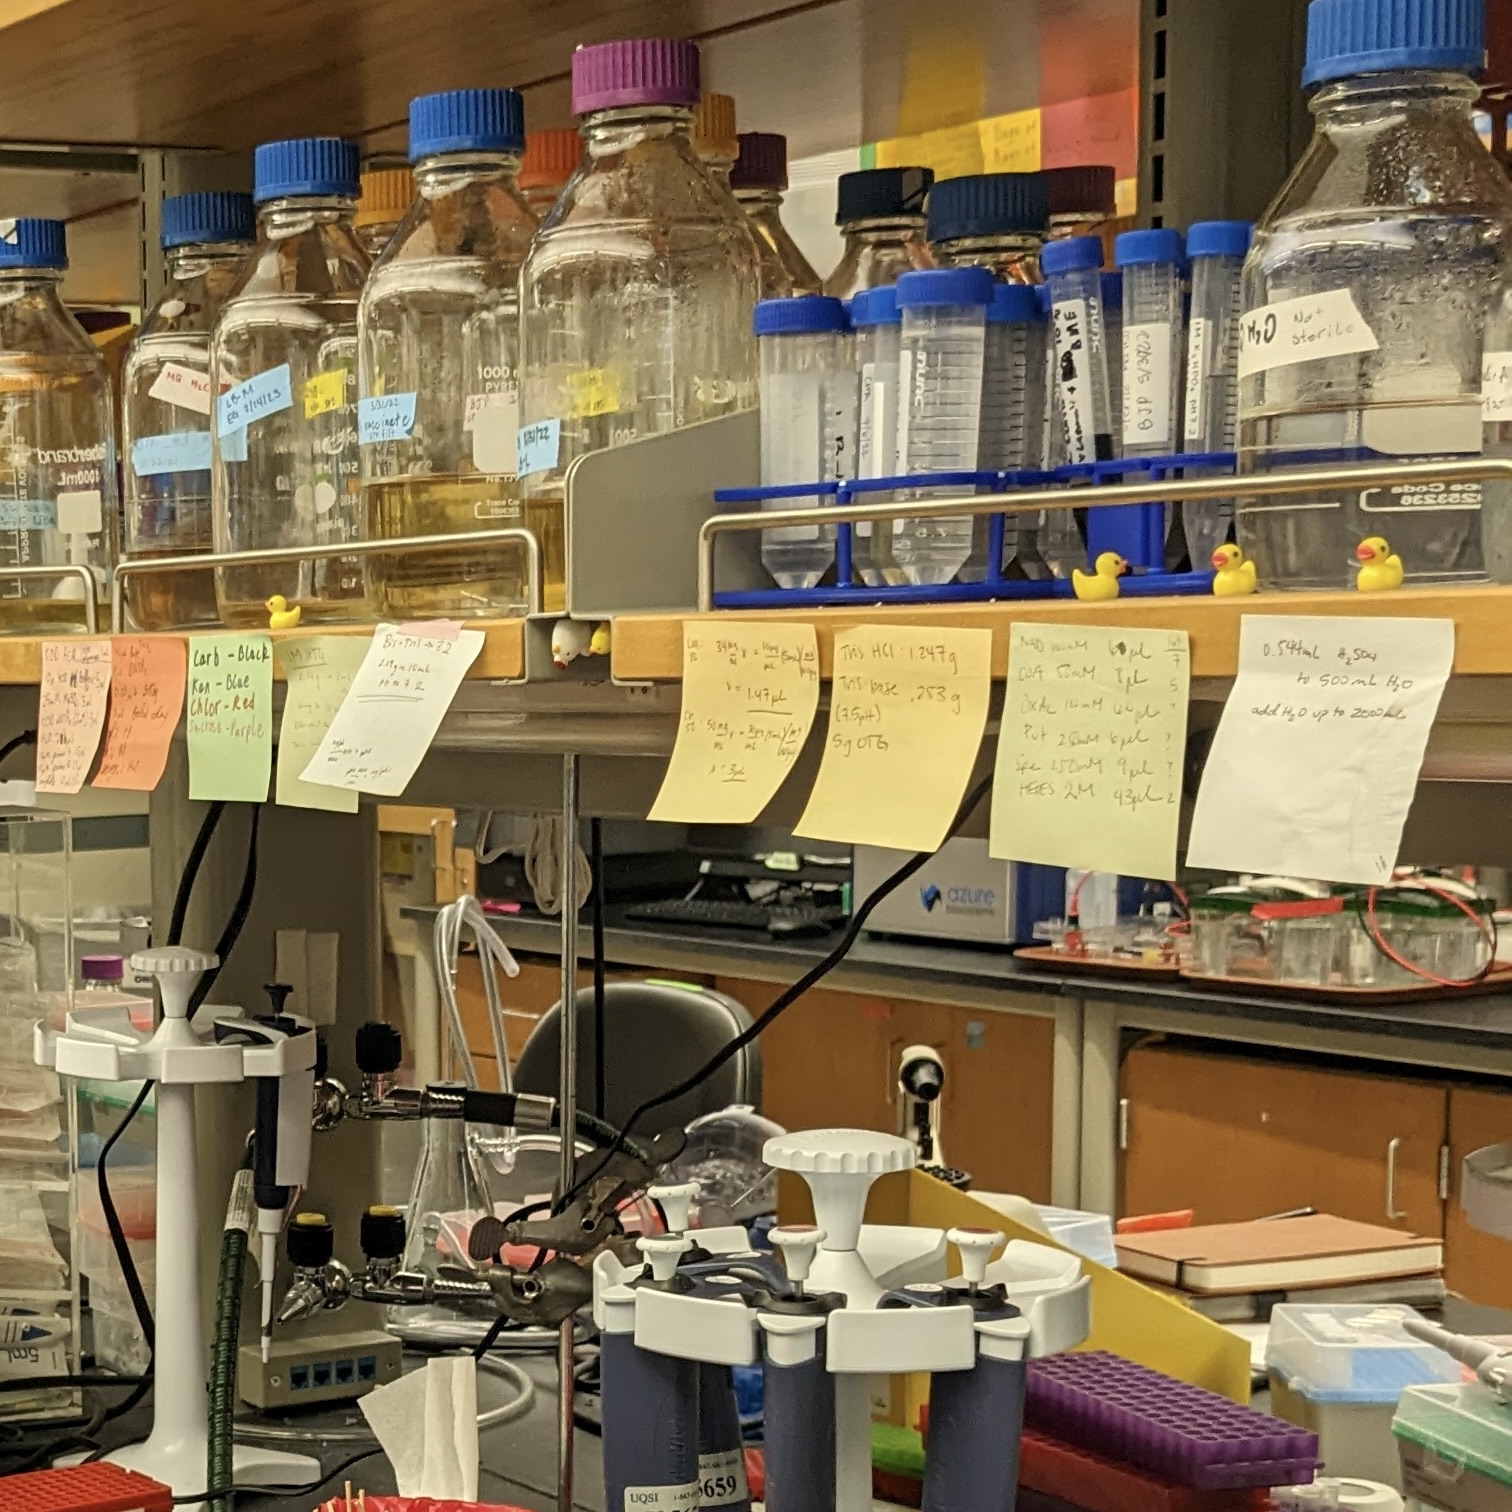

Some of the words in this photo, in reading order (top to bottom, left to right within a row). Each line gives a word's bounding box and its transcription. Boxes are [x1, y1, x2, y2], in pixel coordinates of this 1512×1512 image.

[1293, 307, 1324, 324] Not
[477, 366, 510, 380] 1000
[915, 350, 927, 424] nunc
[193, 646, 219, 667] Carb
[238, 642, 270, 663] Black
[192, 678, 210, 695] Kan
[226, 673, 250, 691] Blue
[1297, 671, 1310, 685] to
[190, 696, 222, 717] Chlor
[232, 692, 255, 711] Red
[1251, 703, 1281, 717] add
[1312, 709, 1329, 722] up
[1332, 705, 1345, 718] to
[947, 887, 996, 905] azure
[630, 1492, 659, 1503] UQSI
